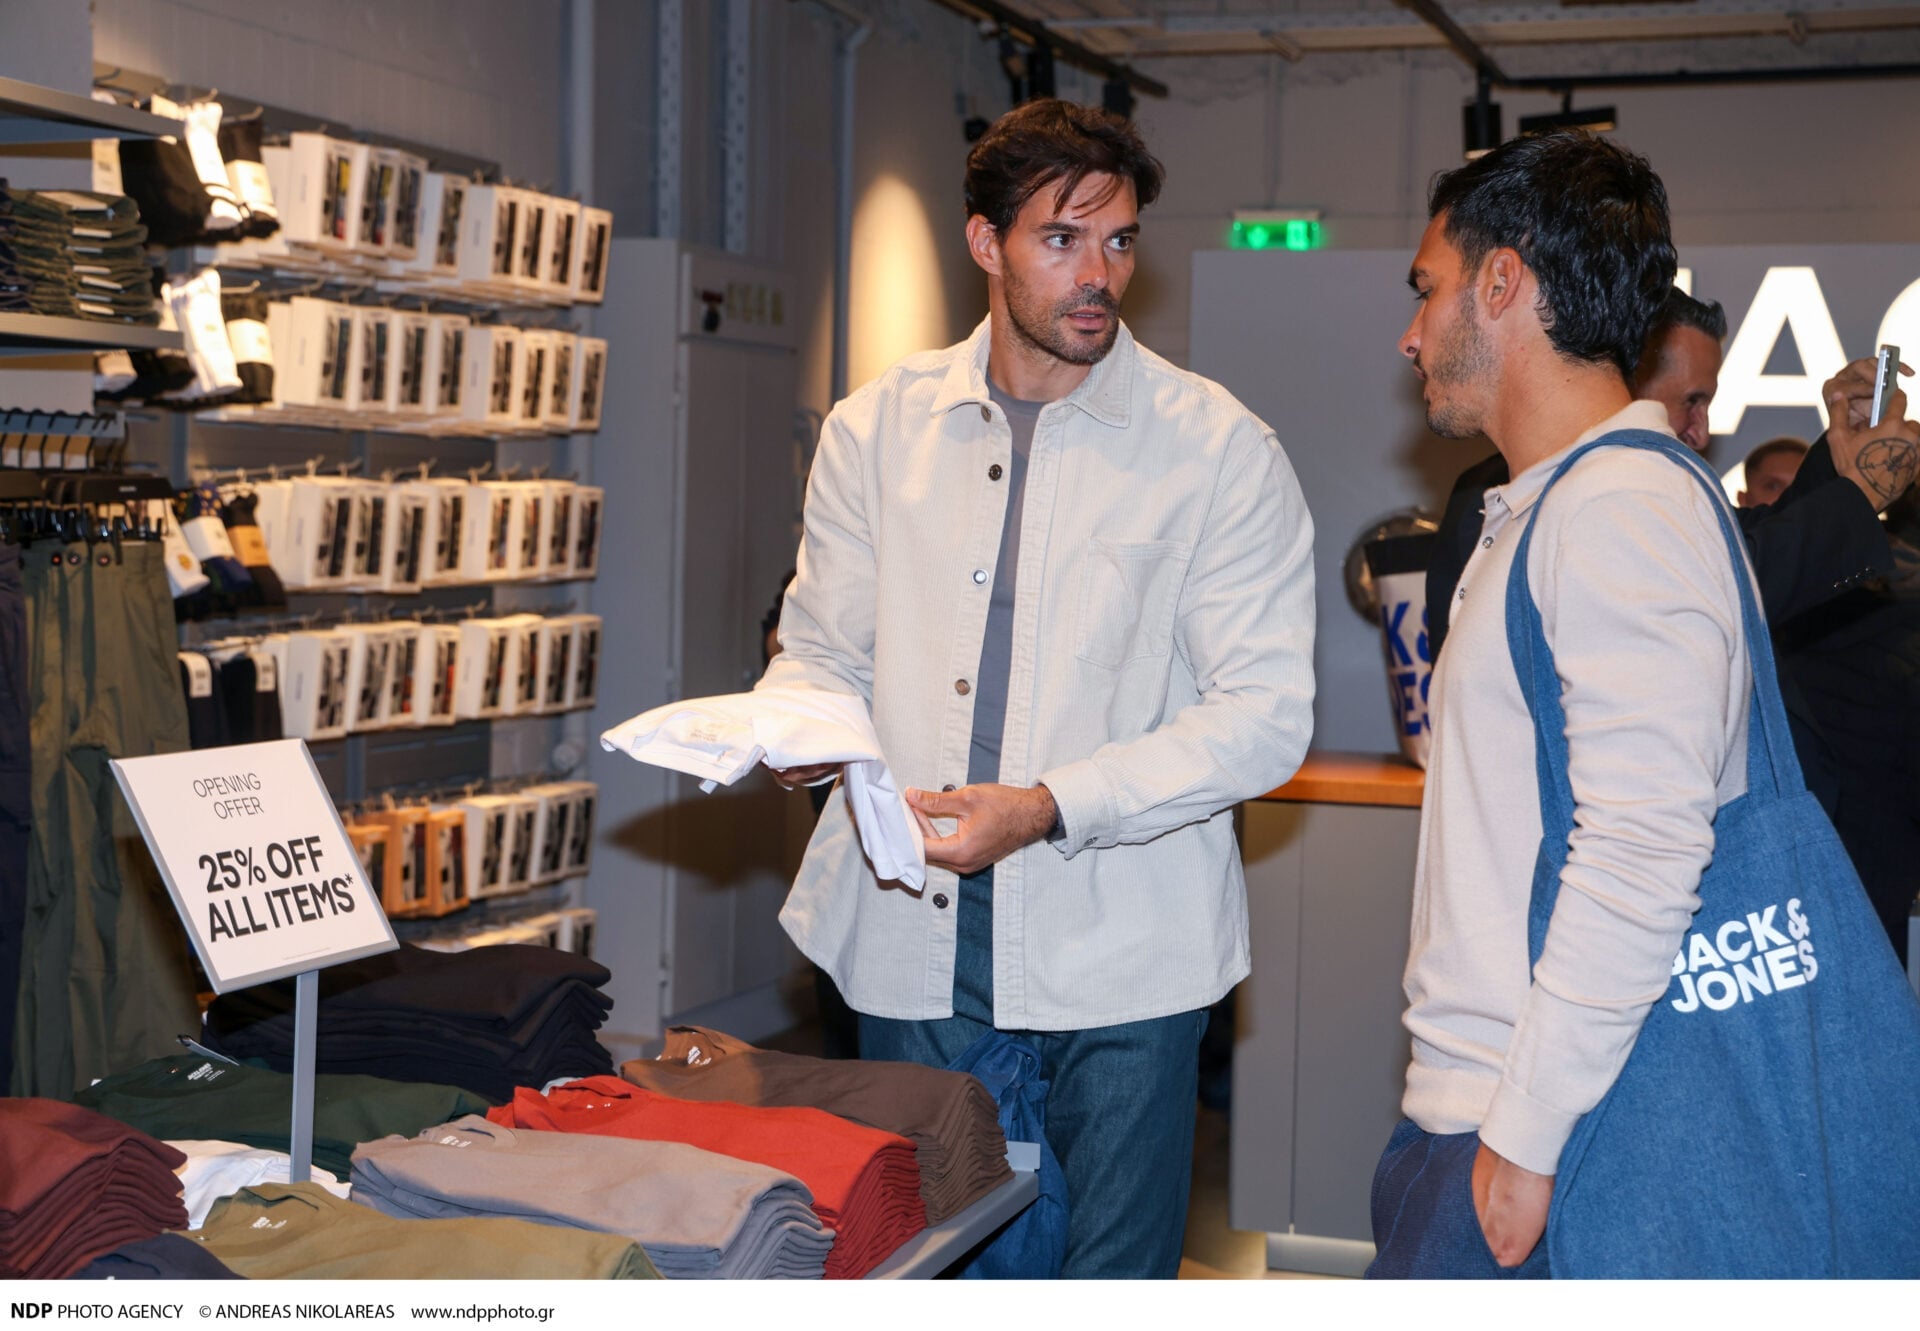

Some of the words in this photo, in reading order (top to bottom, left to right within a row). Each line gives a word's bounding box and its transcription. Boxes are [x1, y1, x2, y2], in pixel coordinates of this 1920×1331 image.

[193, 773, 262, 798] OPENING
[213, 796, 265, 820] OFFER
[199, 846, 267, 893] 25%
[266, 835, 324, 879] OFF
[209, 895, 268, 943] ALL
[1671, 939, 1819, 1013] JONES
